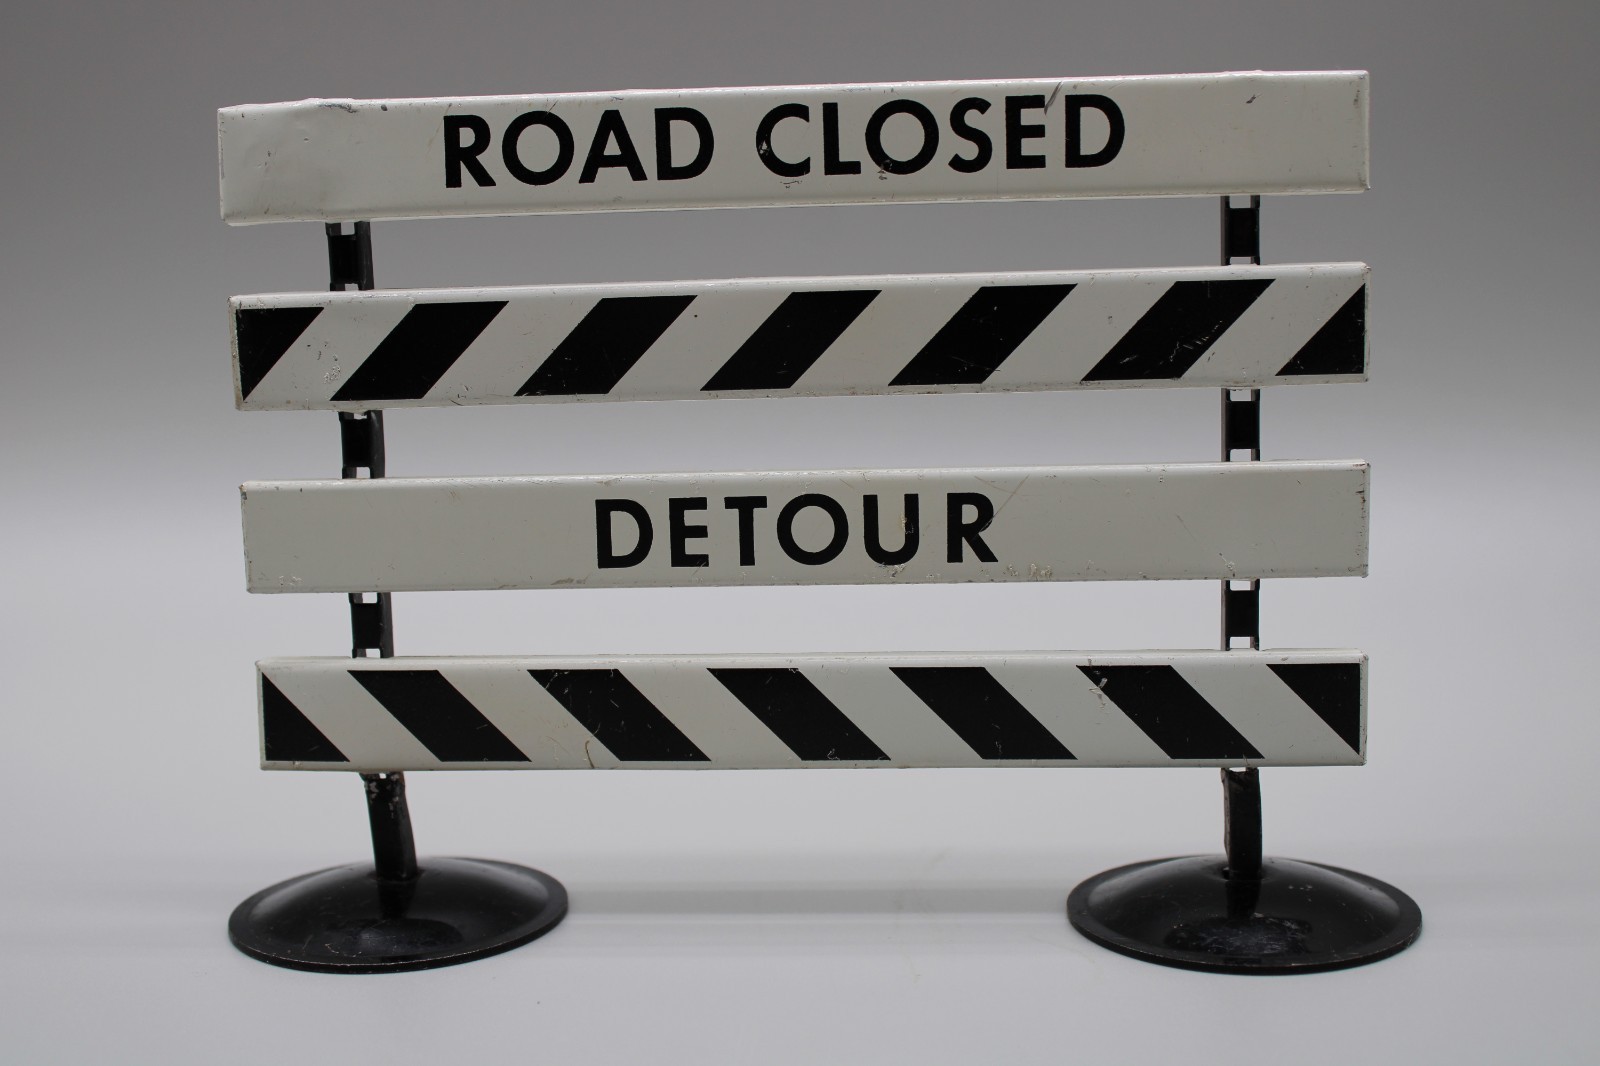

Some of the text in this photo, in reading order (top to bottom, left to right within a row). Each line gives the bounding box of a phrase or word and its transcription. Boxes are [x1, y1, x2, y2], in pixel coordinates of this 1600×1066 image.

[443, 94, 1125, 188] ROAD CLOSED
[595, 492, 999, 569] DETOUR
